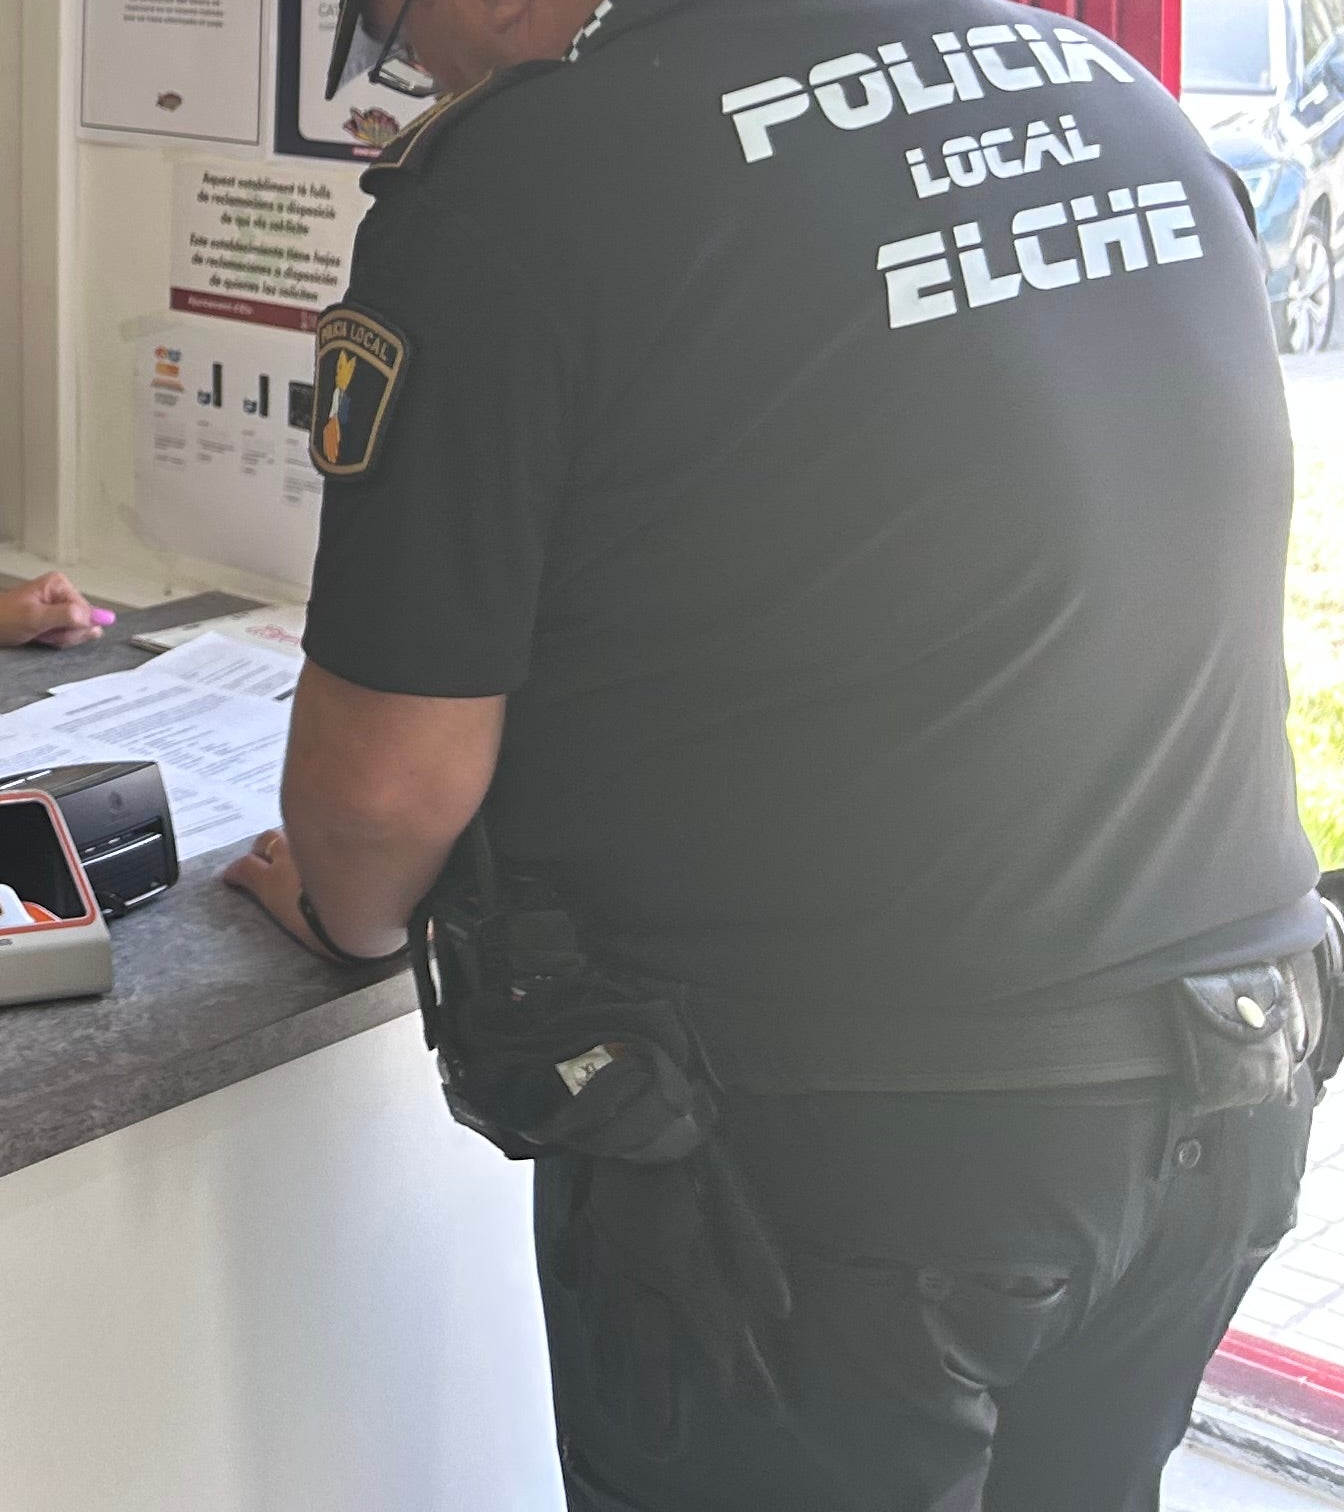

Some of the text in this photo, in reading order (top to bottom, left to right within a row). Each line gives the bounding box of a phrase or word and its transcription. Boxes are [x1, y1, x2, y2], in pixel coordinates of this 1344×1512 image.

[721, 24, 1134, 164] POLICIA
[906, 114, 1101, 199] LOCAL
[876, 180, 1204, 330] ELCHE
[350, 323, 388, 361] LOCAL
